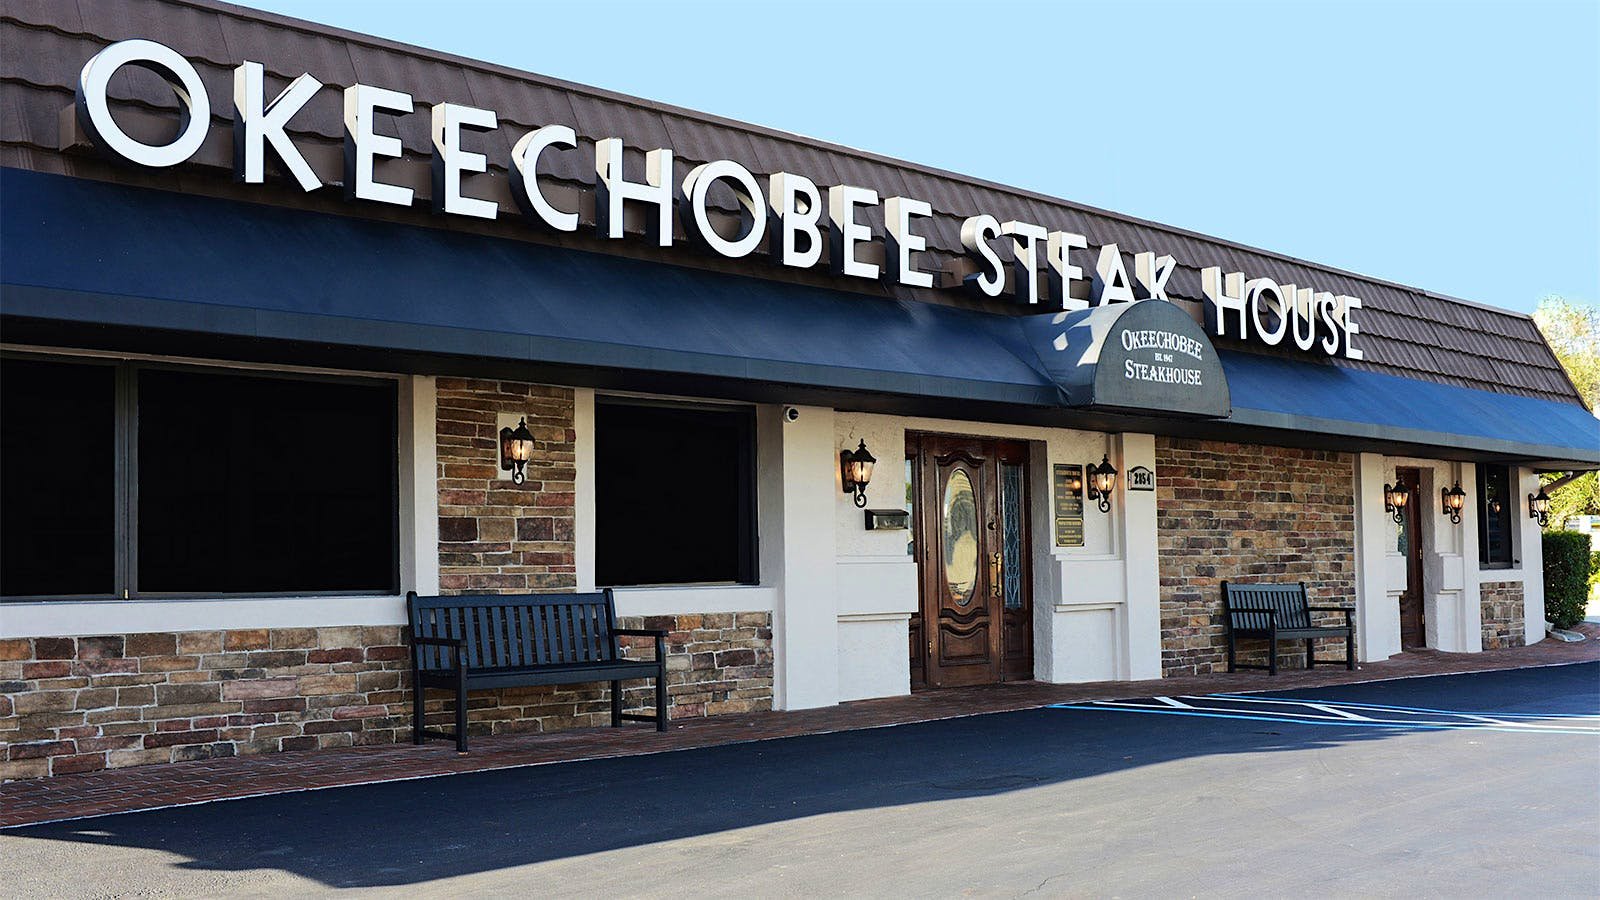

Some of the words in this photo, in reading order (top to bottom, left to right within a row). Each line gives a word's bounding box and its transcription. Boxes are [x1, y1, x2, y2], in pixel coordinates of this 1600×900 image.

[80, 38, 934, 289] OKEECHOBEE
[971, 214, 1177, 311] STEAK
[1212, 266, 1364, 361] HOUSE
[1121, 329, 1203, 361] OKEECHOBEE
[1124, 359, 1203, 386] STEAKHOUSE
